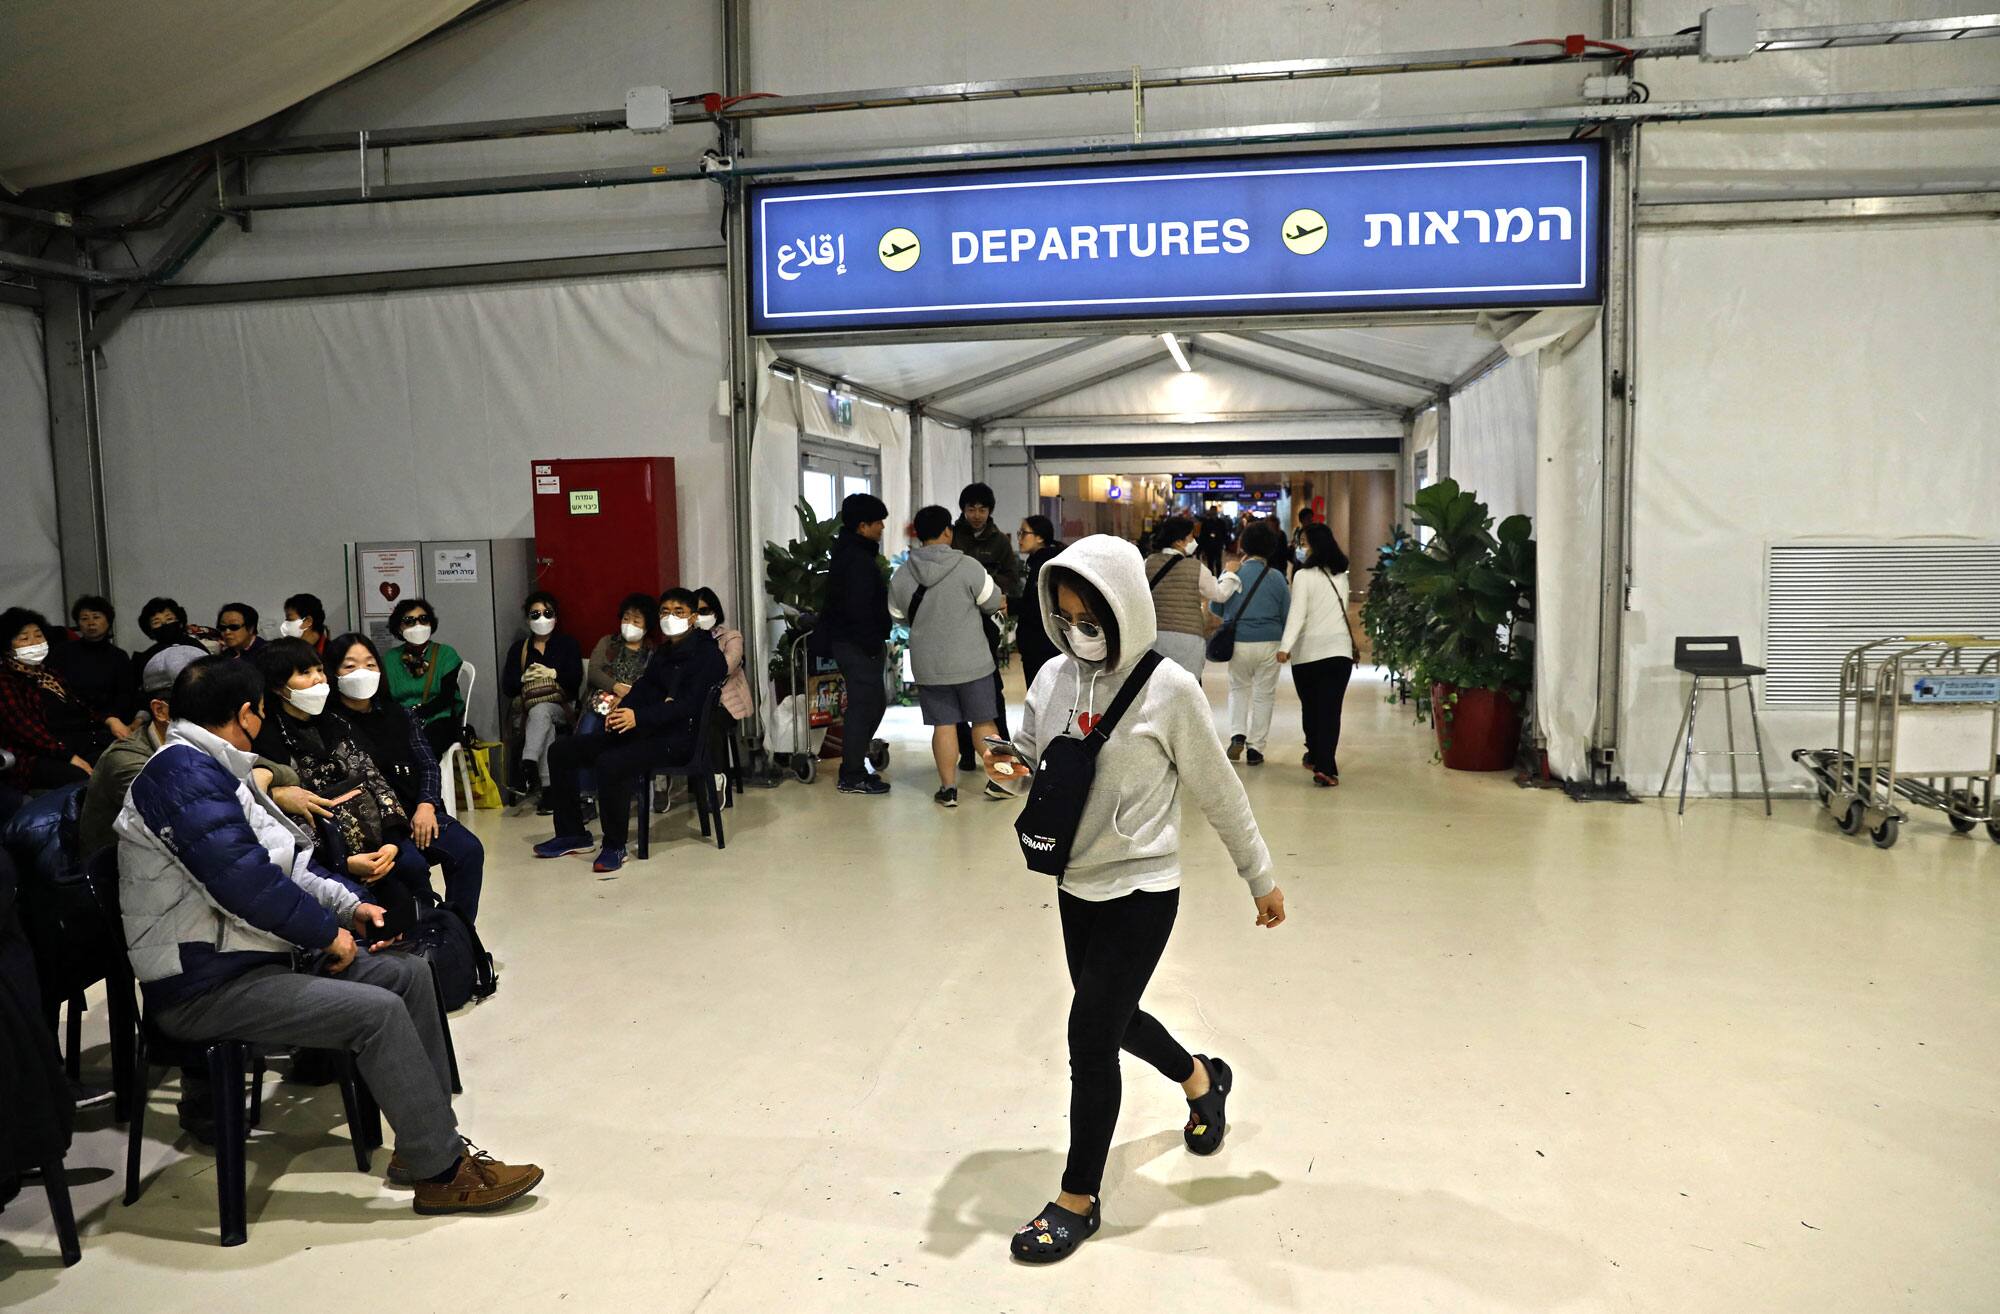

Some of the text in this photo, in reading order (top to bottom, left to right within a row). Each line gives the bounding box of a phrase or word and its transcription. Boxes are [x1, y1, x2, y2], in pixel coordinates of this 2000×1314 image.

[950, 217, 1250, 266] DEPARTURES
[1363, 206, 1572, 248] המראות
[777, 233, 848, 281] إقلاع
